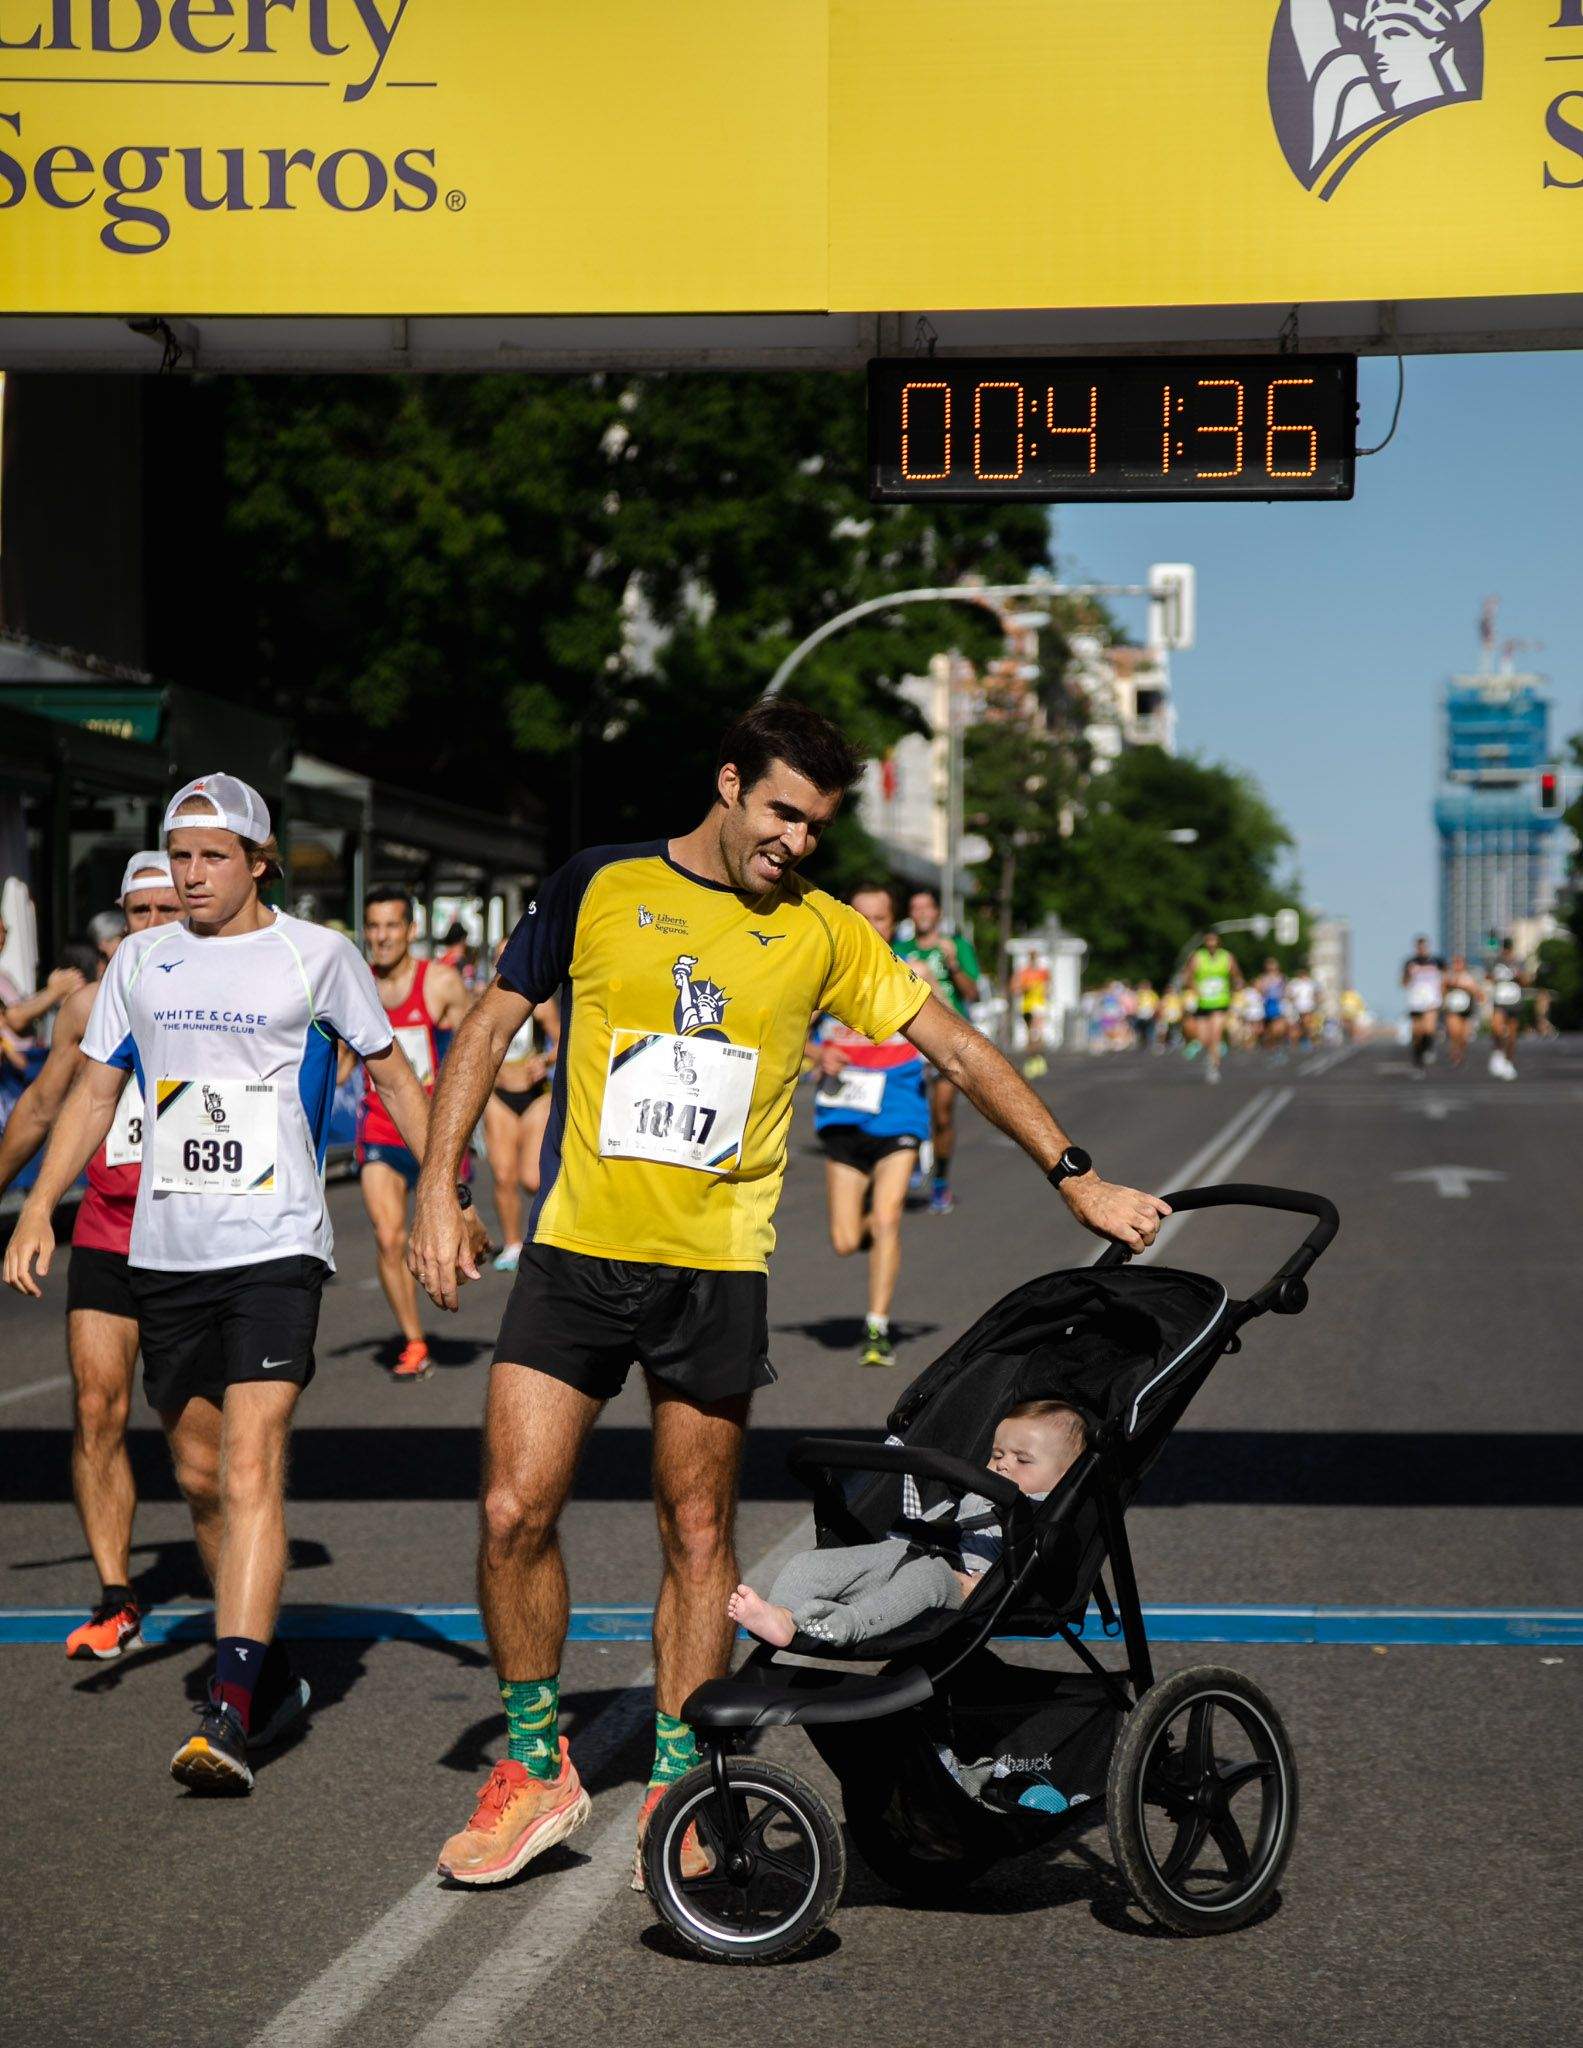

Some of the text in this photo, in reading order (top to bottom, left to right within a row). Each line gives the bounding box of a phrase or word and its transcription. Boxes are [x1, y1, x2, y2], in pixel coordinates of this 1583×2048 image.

[657, 914, 687, 925] Liberty
[154, 1010, 267, 1026] WHITE & CASE
[163, 1023, 255, 1035] THE RUNNERS CLUB
[183, 1138, 243, 1173] 639
